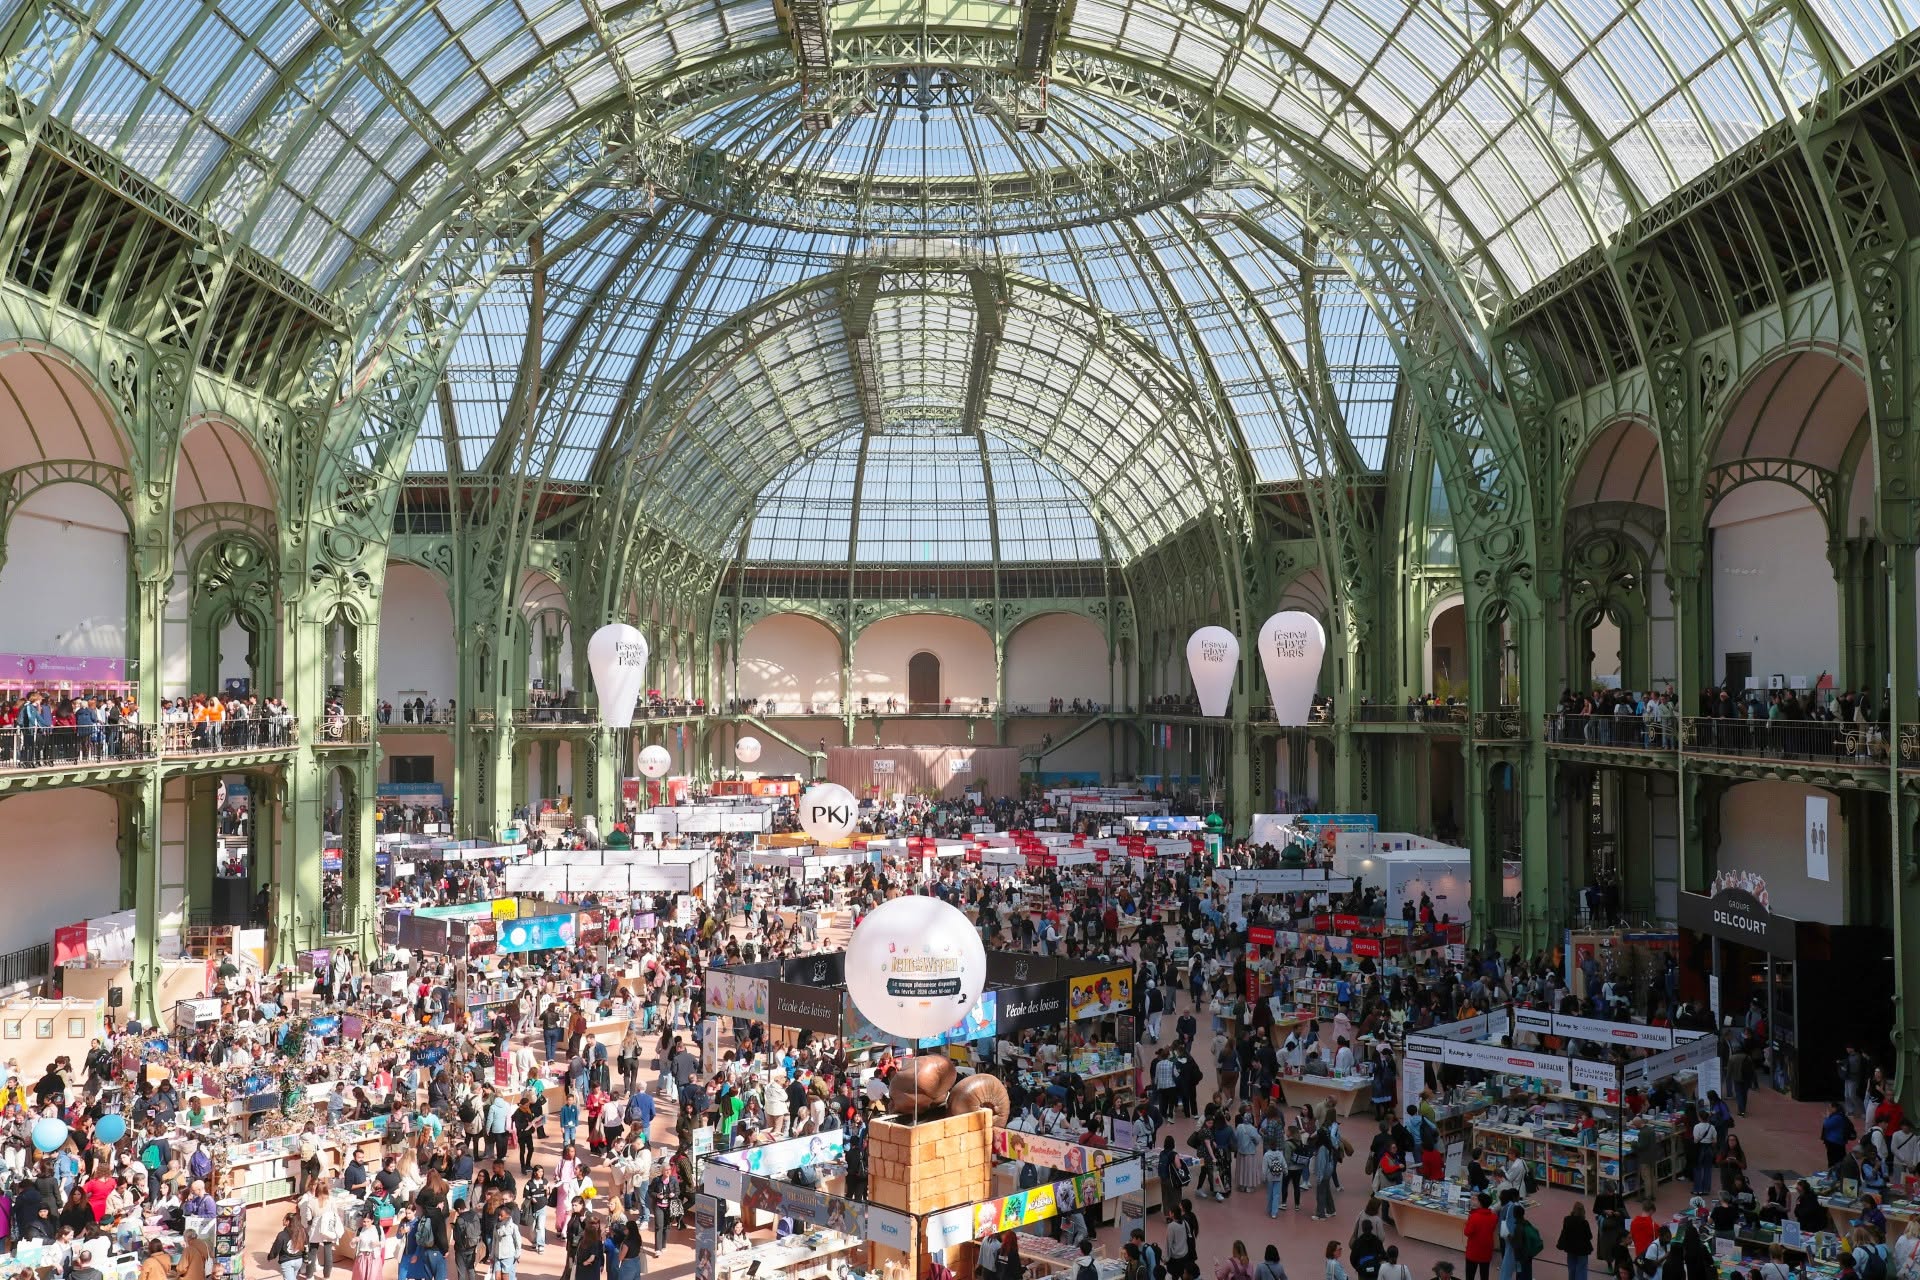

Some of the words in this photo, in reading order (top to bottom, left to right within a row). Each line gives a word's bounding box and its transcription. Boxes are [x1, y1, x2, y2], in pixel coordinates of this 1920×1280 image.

[1274, 629, 1307, 641] Festival
[1201, 640, 1228, 649] Festival
[1284, 638, 1307, 649] Livre
[1203, 653, 1224, 662] Paris
[1277, 647, 1304, 658] Paris
[1728, 899, 1750, 912] GROUPE
[1713, 910, 1767, 935] DELCOURT
[1355, 943, 1376, 951] DUPUIS
[777, 997, 798, 1013] l'école
[799, 1000, 811, 1014] des
[811, 1003, 831, 1019] loisirs
[1005, 1003, 1027, 1018] l'école
[1027, 1000, 1039, 1014] des
[1039, 998, 1060, 1013] loisirs
[308, 1022, 334, 1032] LUMEN
[1518, 1016, 1548, 1027] casterman
[1641, 1032, 1668, 1043] SARBACANE
[1409, 1044, 1441, 1055] casterman
[416, 1051, 441, 1060] LUMEN
[1507, 1058, 1534, 1067] casterman
[1538, 1061, 1565, 1073] SARBACANE
[1574, 1065, 1614, 1077] GALLIMARD
[1575, 1071, 1614, 1083] JEUNESSE
[238, 1077, 273, 1089] LUMEN
[1028, 1197, 1054, 1211] ACADEMIA
